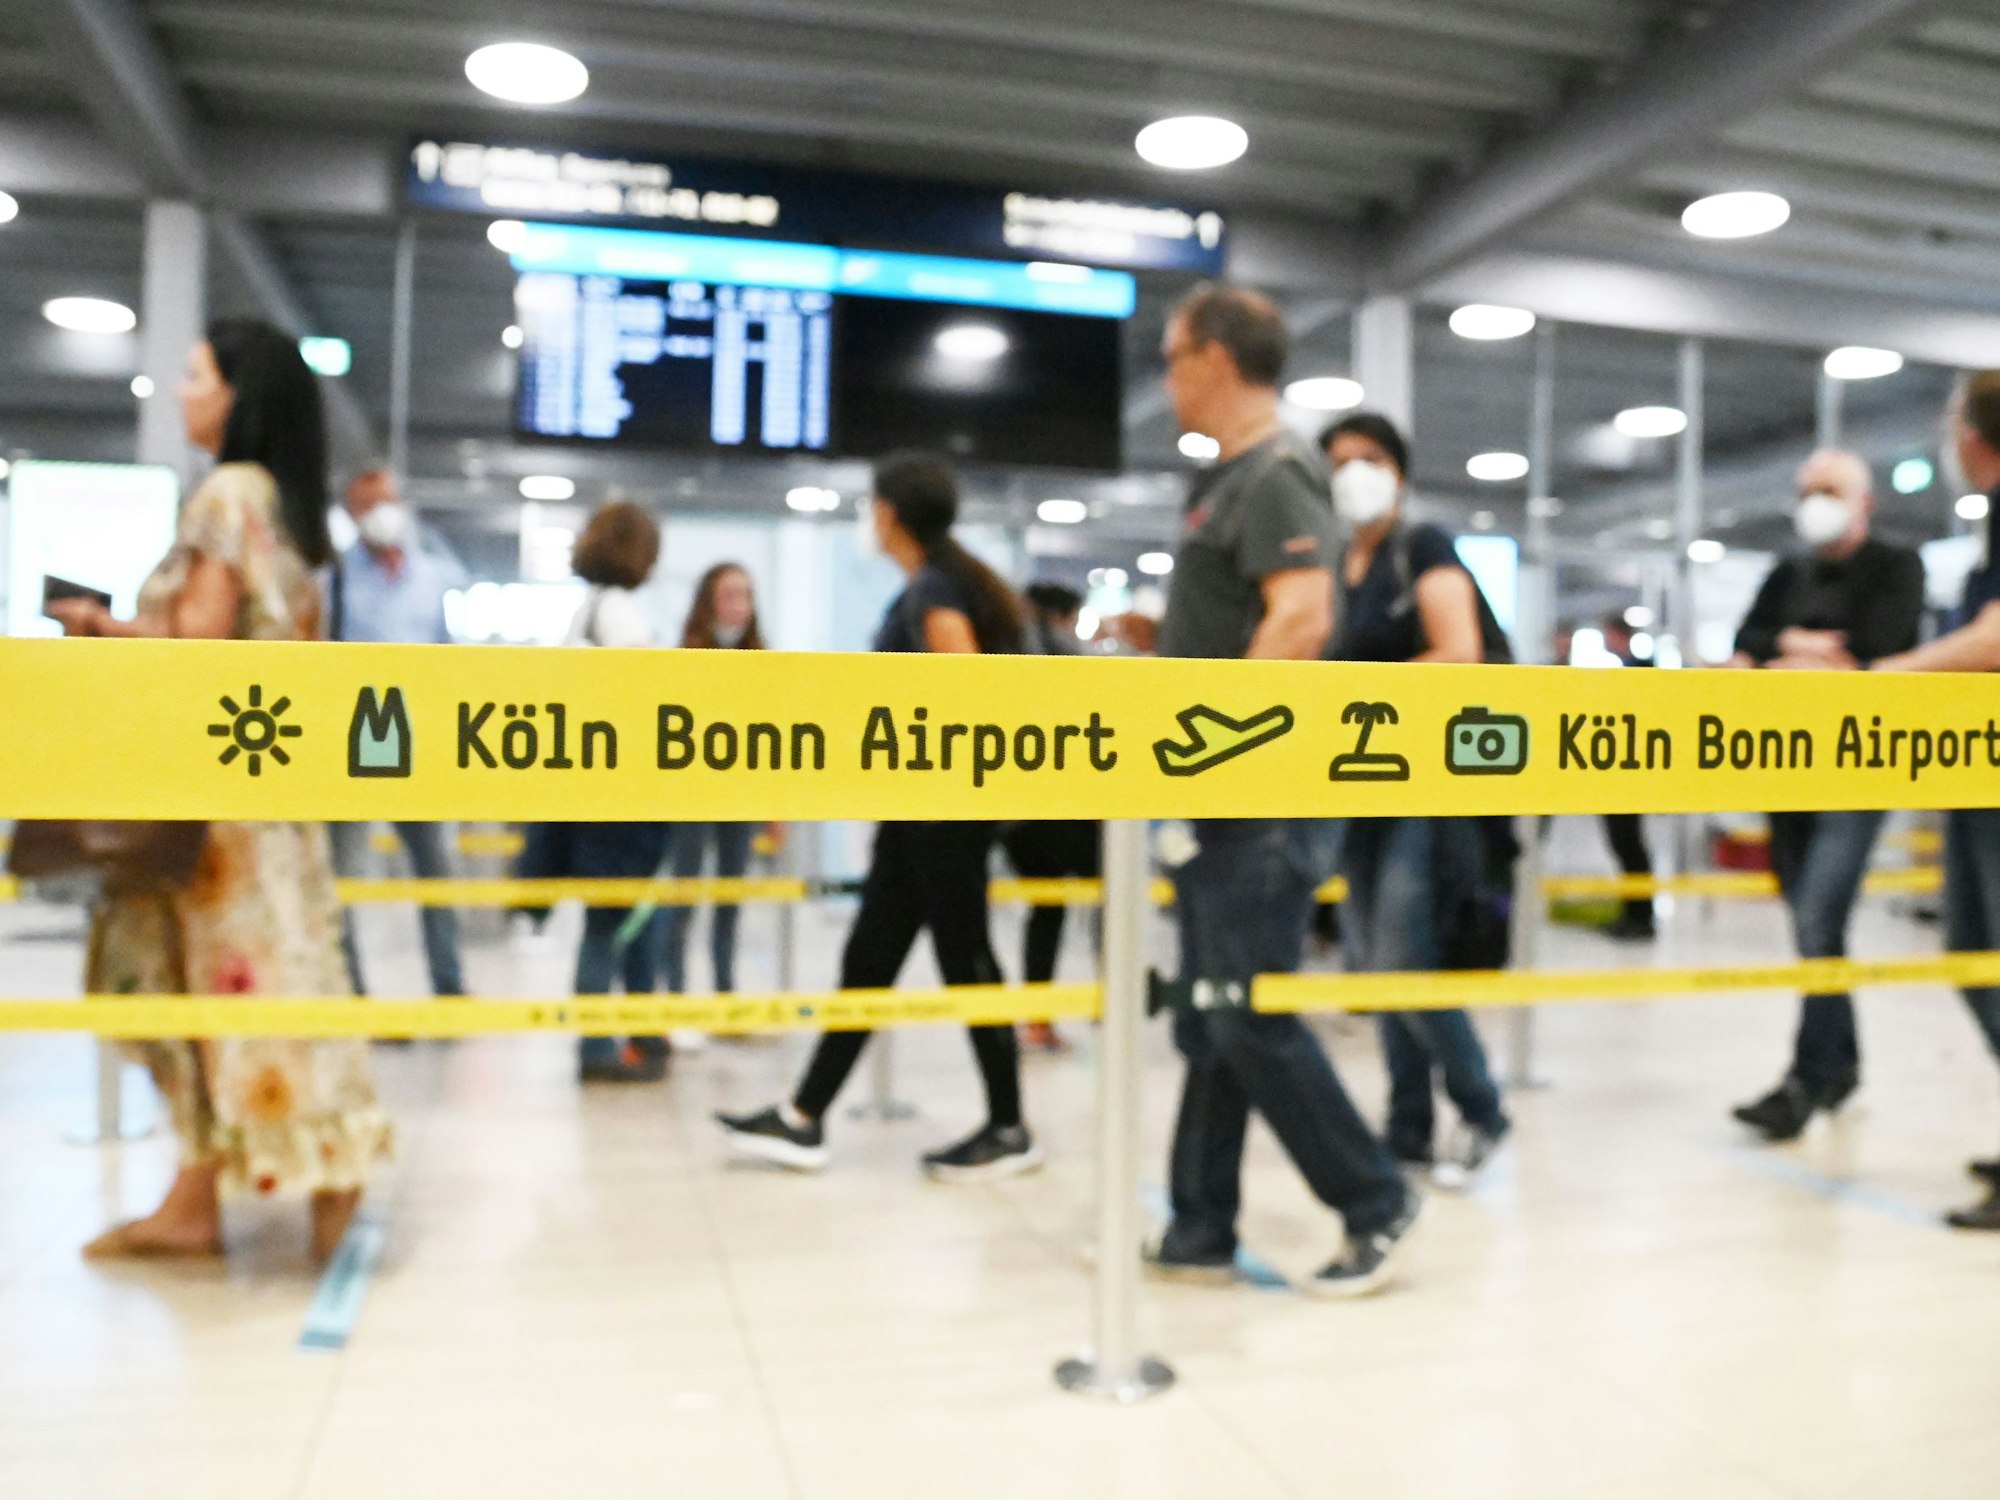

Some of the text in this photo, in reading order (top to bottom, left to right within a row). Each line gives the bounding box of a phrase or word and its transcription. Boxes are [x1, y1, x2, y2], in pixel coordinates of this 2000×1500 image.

[457, 702, 1118, 788] Köln Bonn Airport
[1559, 713, 2000, 782] Köln Bonn Airport
